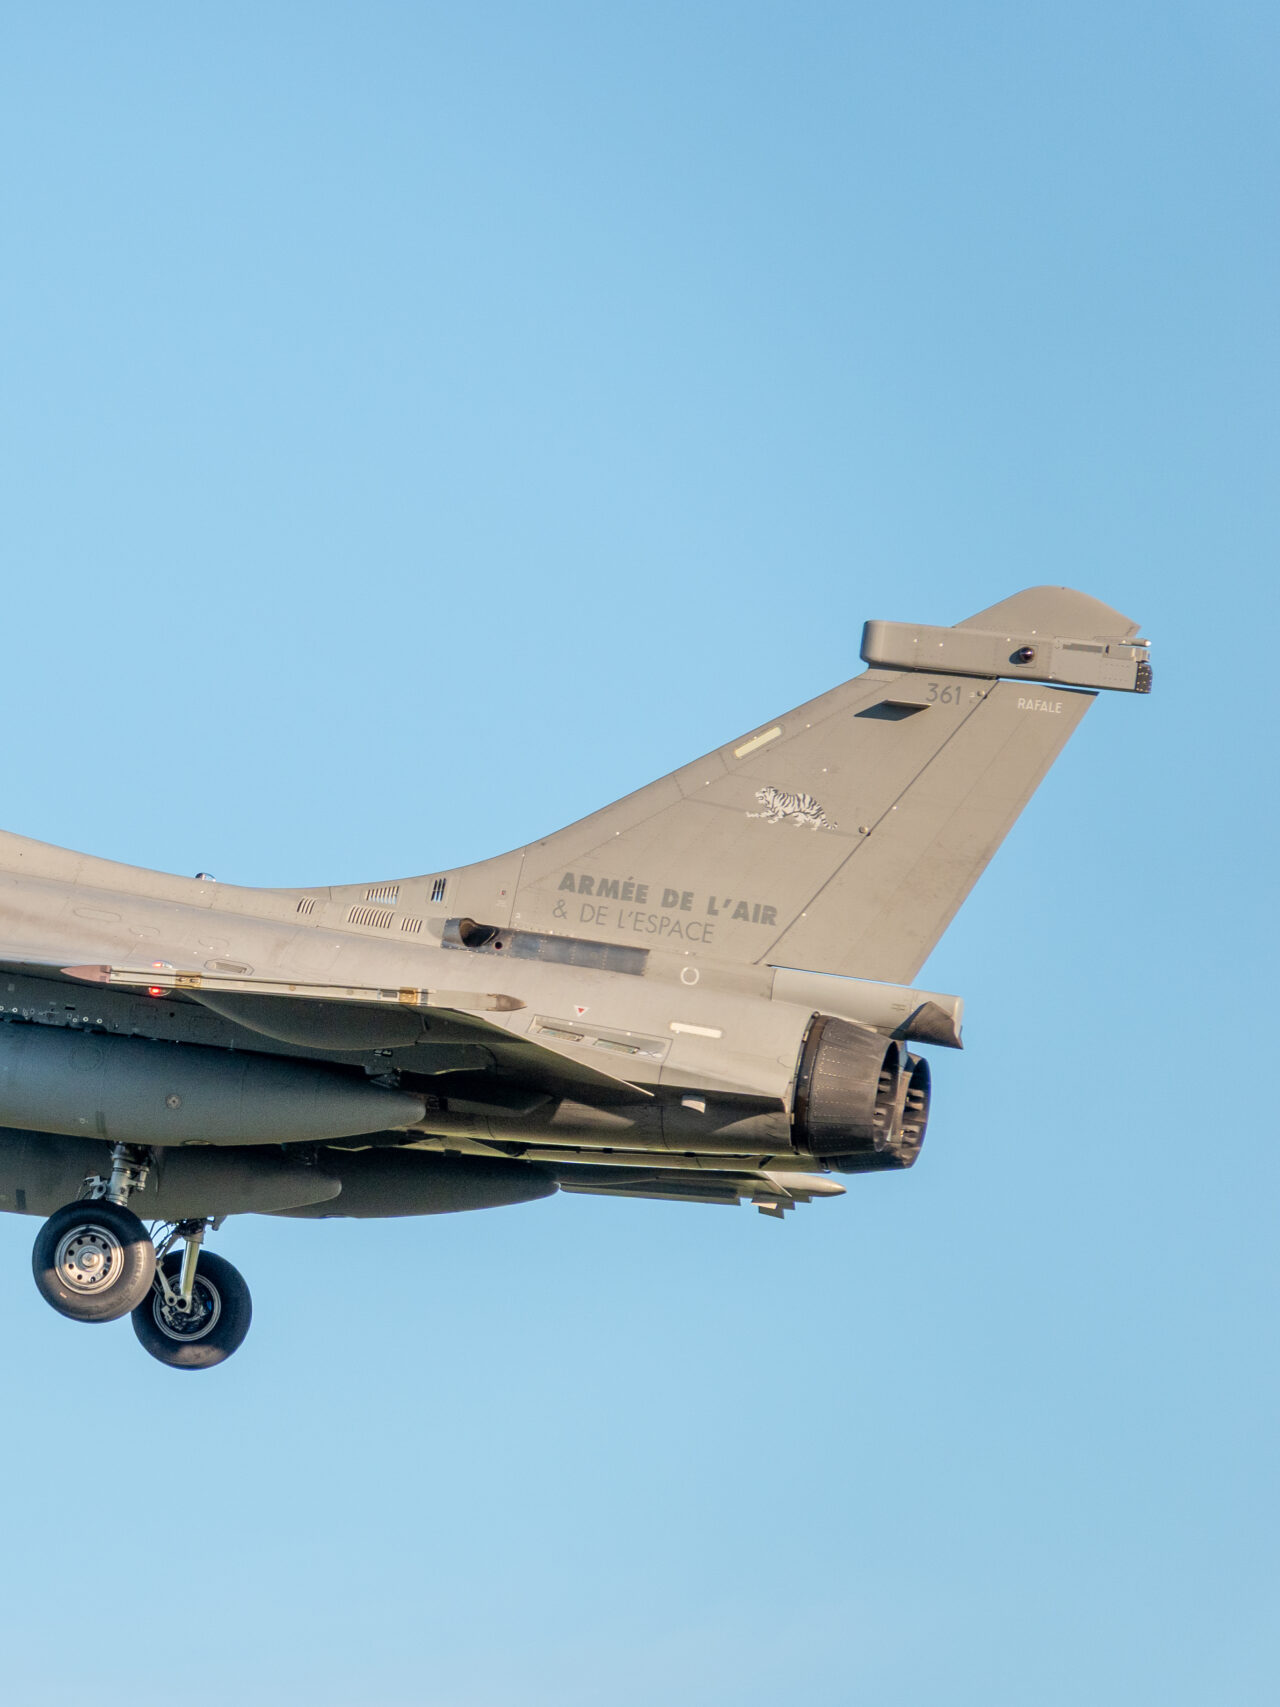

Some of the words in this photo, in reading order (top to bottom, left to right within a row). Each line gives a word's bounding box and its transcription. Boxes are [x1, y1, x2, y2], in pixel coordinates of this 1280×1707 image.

[925, 682, 962, 706] 361
[1017, 697, 1063, 714] RAFALE
[558, 871, 649, 904] ARMÉE
[660, 888, 694, 912] DE
[552, 899, 568, 920] &
[579, 903, 609, 926] DE
